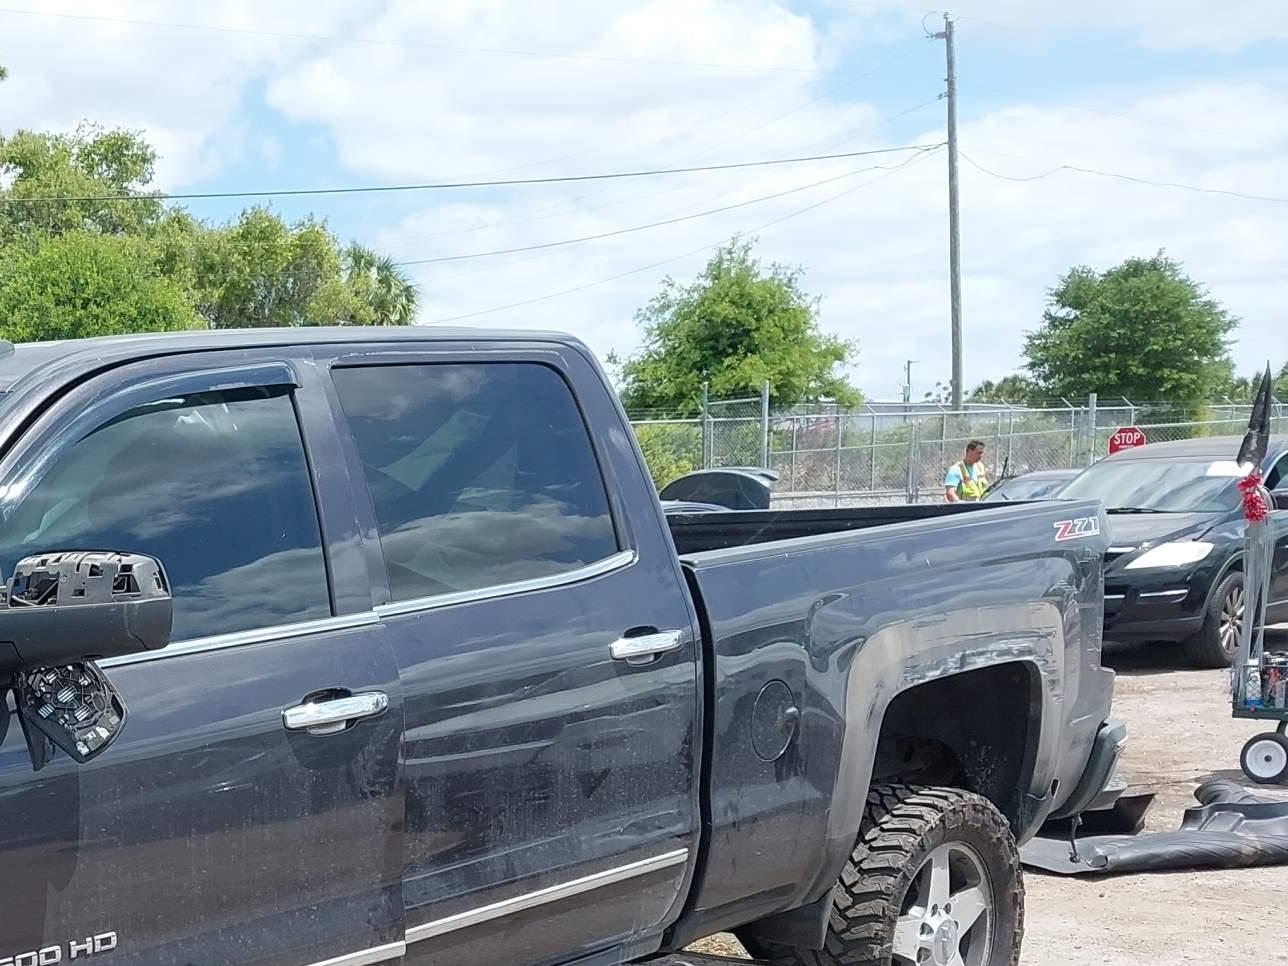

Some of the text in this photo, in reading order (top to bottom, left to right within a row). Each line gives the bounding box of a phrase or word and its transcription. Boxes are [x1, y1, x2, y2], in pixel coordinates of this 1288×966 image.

[1114, 432, 1141, 444] STOP
[1053, 516, 1100, 541] Z71
[69, 931, 118, 960] HD
